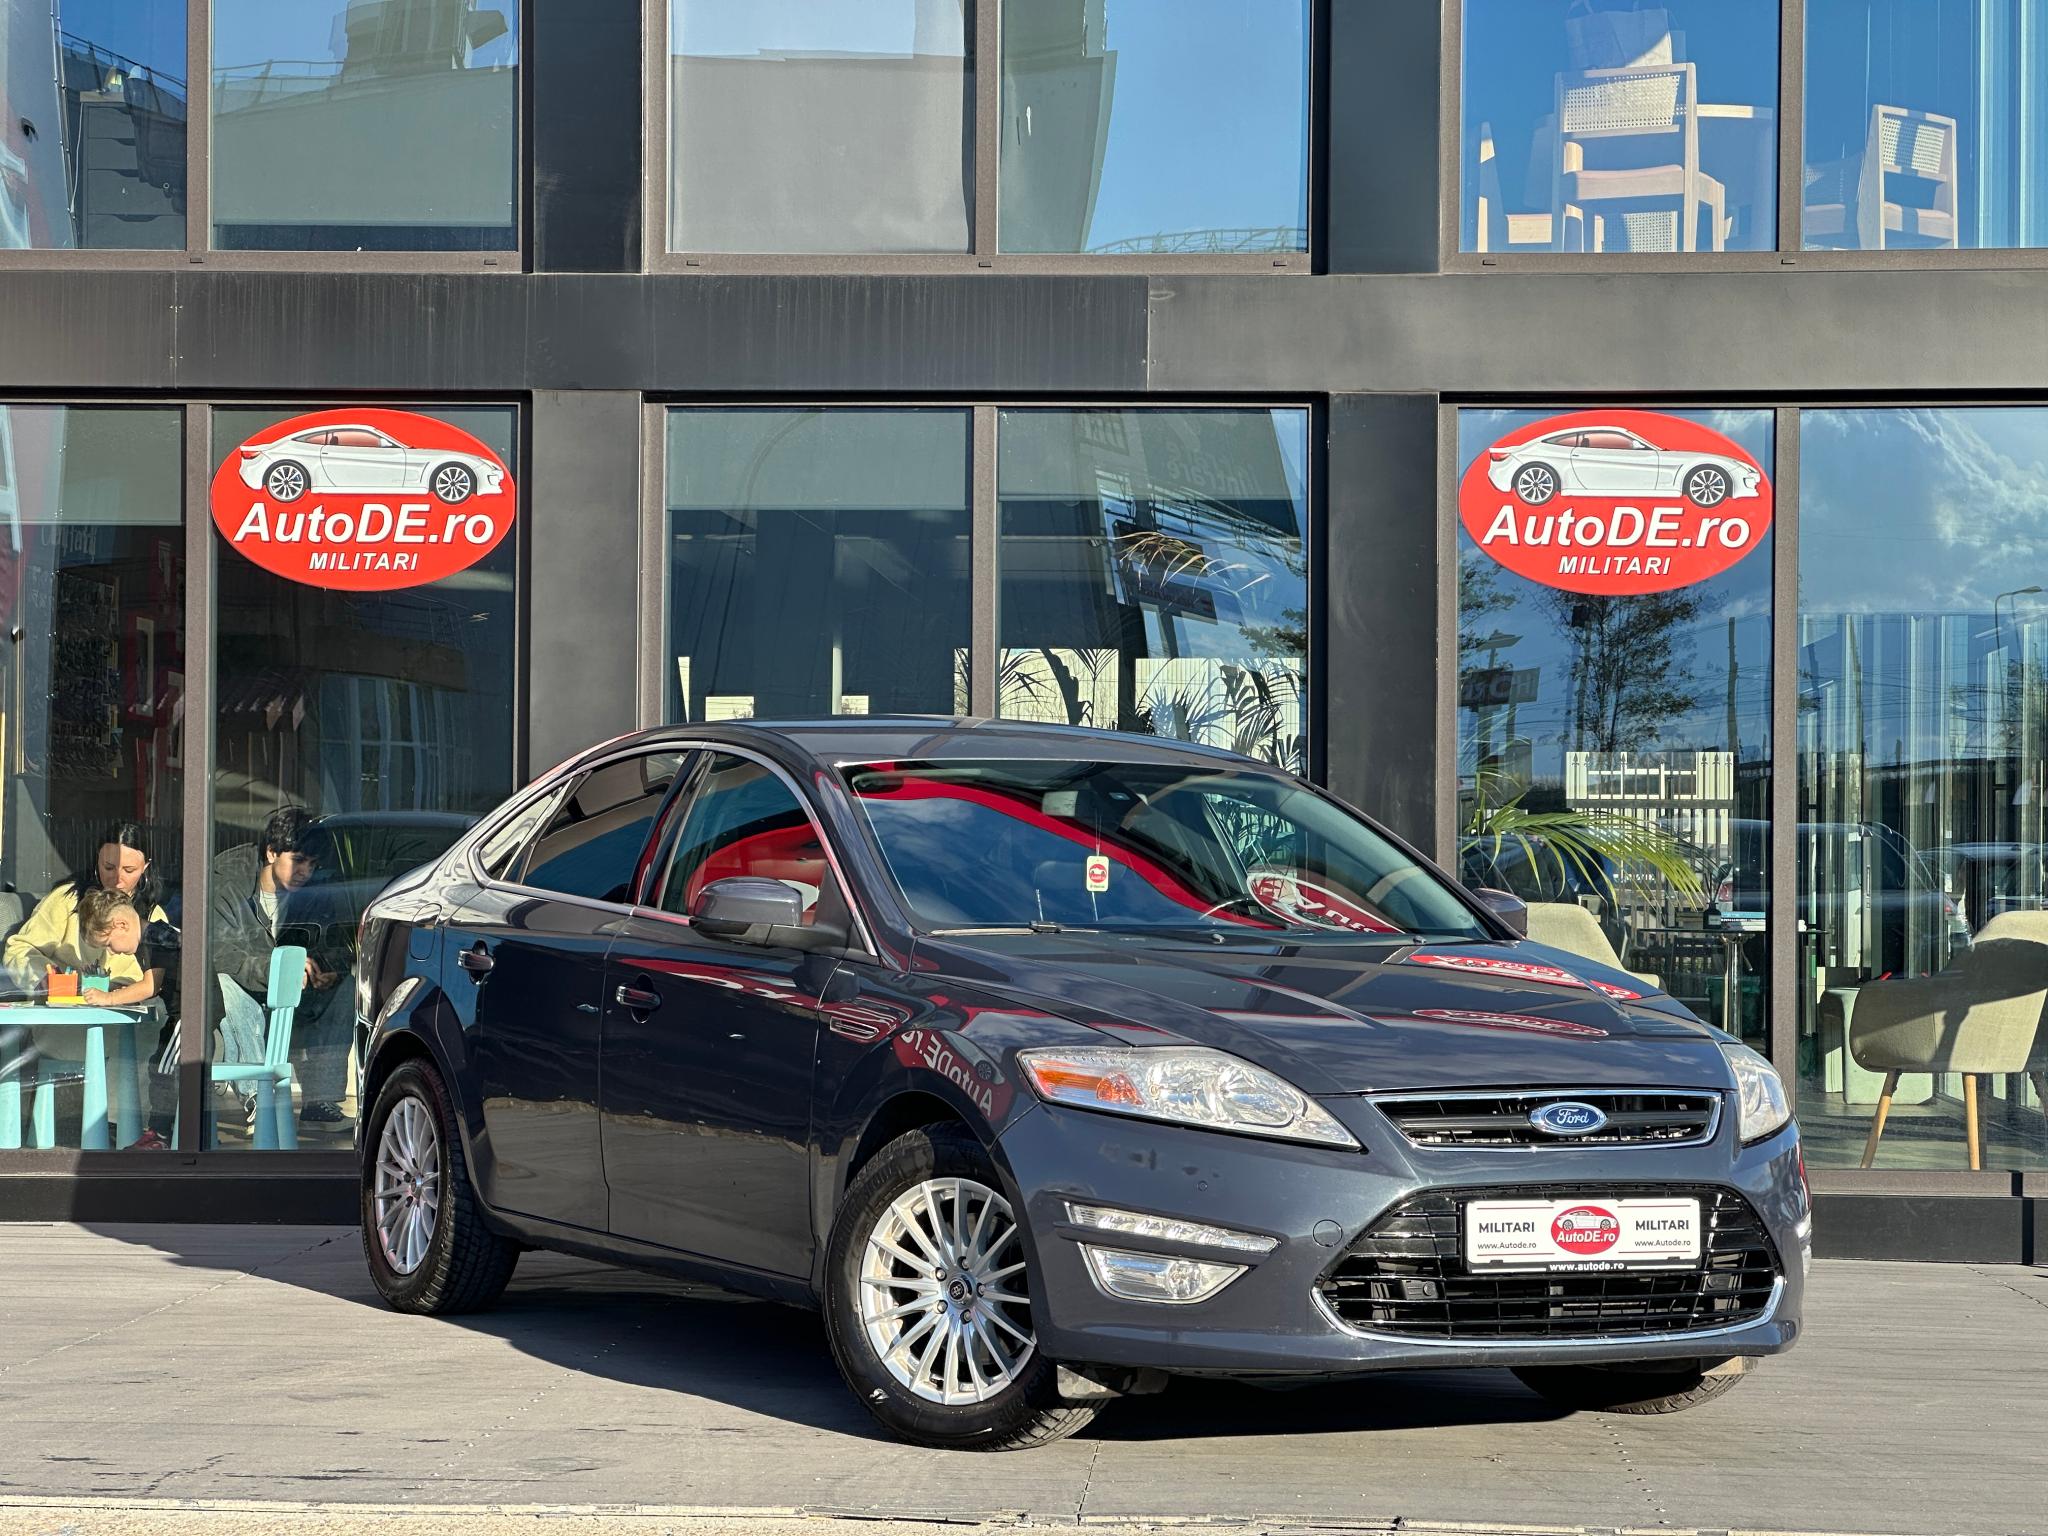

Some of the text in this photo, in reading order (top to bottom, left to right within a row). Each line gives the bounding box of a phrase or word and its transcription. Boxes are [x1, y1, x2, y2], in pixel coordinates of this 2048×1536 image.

[233, 502, 495, 545] AutoDE.ro
[1481, 506, 1751, 550] AutoDE.ro
[308, 552, 419, 571] MILITARI
[1558, 556, 1672, 576] MILITARI
[1556, 1108, 1590, 1125] Ford
[1478, 1222, 1535, 1234] MILITARI
[1635, 1219, 1690, 1231] MILITARI
[1556, 1230, 1617, 1244] AutoDE.ro
[1634, 1239, 1692, 1248] www.Autode.ro
[1477, 1242, 1537, 1250] www.Autode.ro
[1549, 1262, 1625, 1272] www.autode.ro
